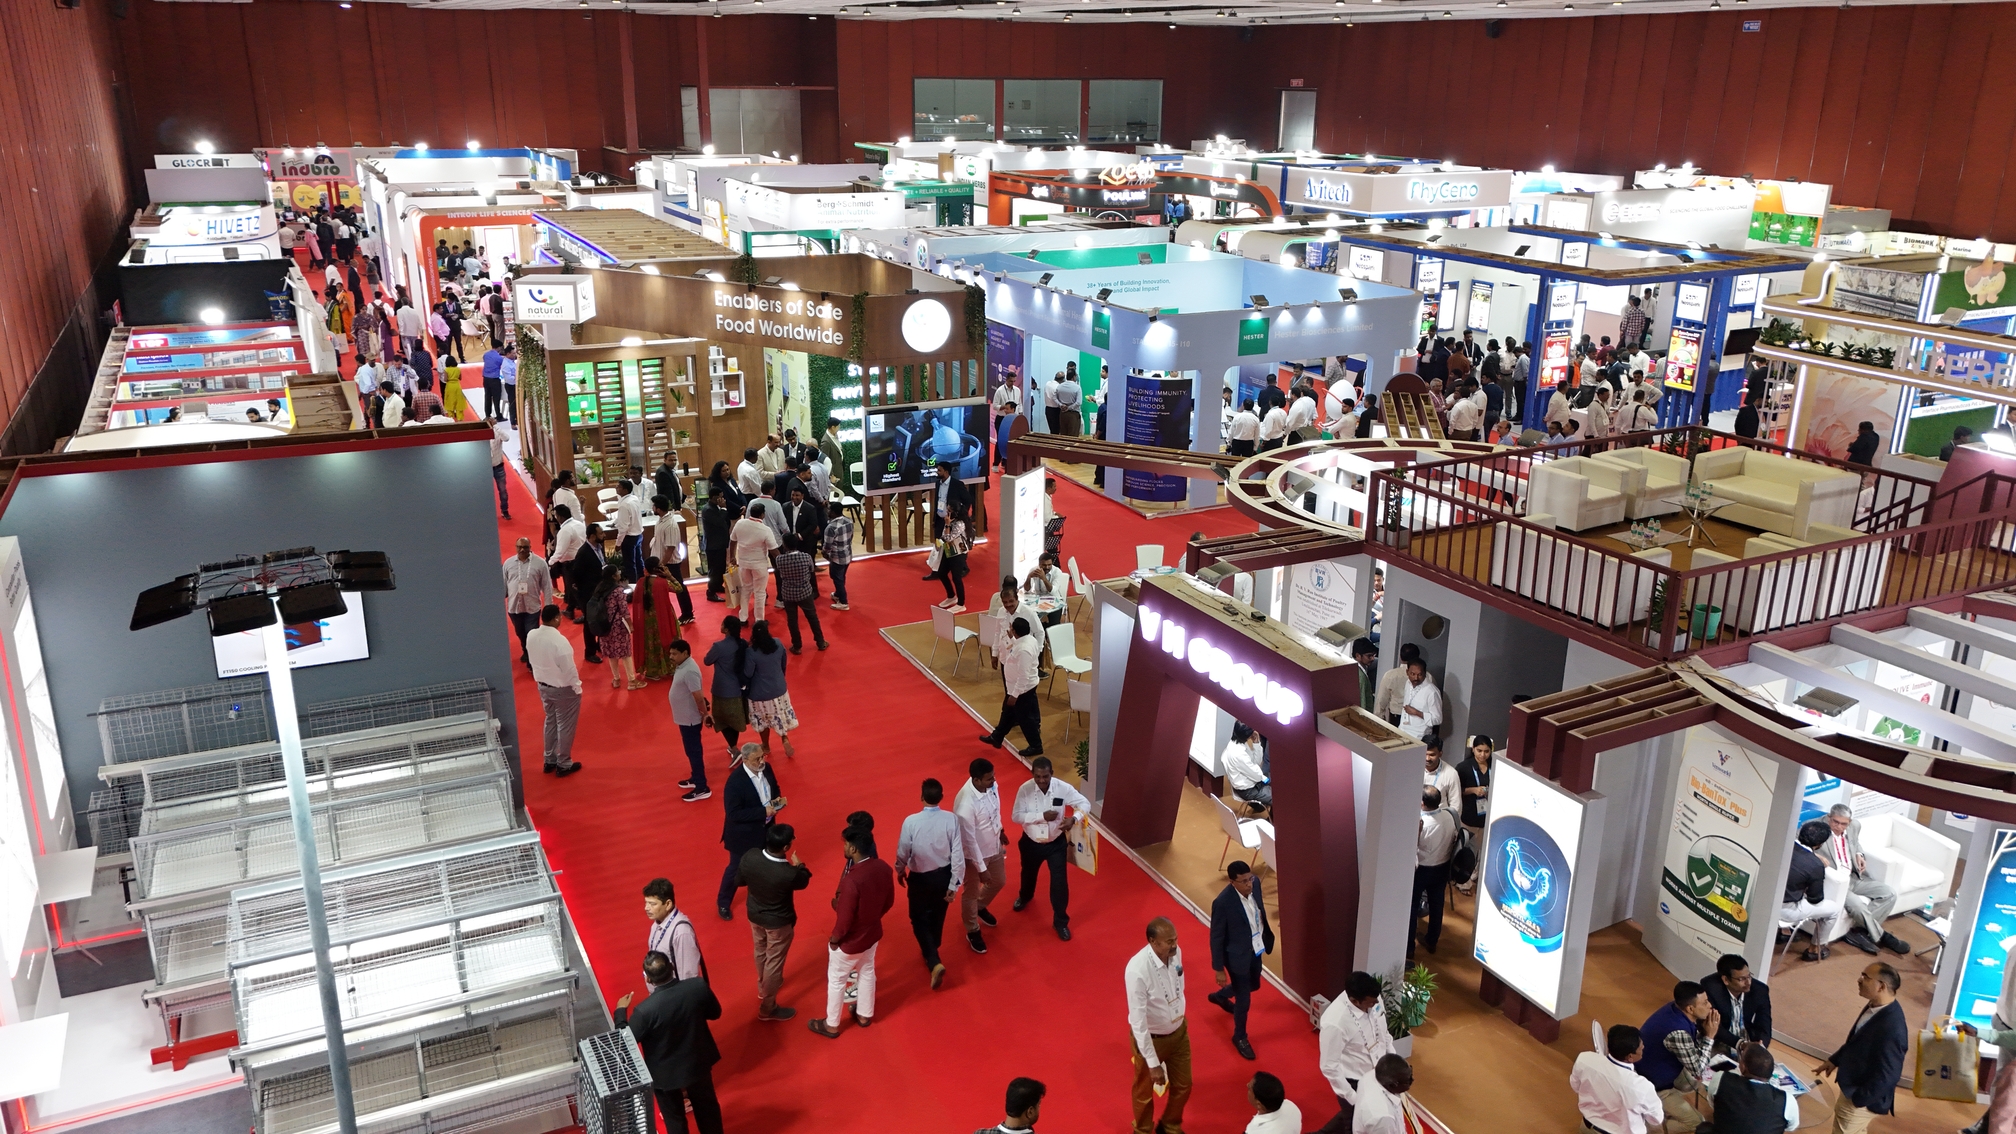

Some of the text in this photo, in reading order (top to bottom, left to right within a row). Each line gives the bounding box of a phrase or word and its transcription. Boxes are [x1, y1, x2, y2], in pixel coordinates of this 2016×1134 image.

[282, 161, 341, 177] indbro
[919, 187, 943, 195] RELIABLE
[1304, 178, 1350, 202] Avitech
[1410, 180, 1479, 203] PhyGeno
[447, 209, 532, 219] INTRON LIFE SCIENCES
[206, 216, 260, 235] HIVETZ
[1903, 237, 1935, 247] BIOMARK
[1120, 279, 1142, 288] Building
[1142, 278, 1171, 286] Innovation,
[1142, 285, 1160, 293] Impact
[528, 305, 563, 314] natural
[714, 289, 843, 321] Enablers of Safe
[715, 314, 844, 347] Food Worldwide
[1094, 326, 1108, 336] HESTER
[1274, 322, 1374, 340] Hester Biosciences Limited
[1128, 386, 1188, 397] BUILDING IMMUNITY,
[1128, 393, 1164, 403] PROTECTING
[1127, 401, 1165, 410] LIVELIHOODS
[882, 472, 900, 480] Highest
[239, 665, 263, 673] COOLING
[1187, 636, 1304, 725] GROUP
[1690, 775, 1727, 808] Bio-BanTox
[1730, 801, 1748, 818] Plus
[1665, 876, 1741, 934] WORKS AGAINST MULTIPLE TOXINS
